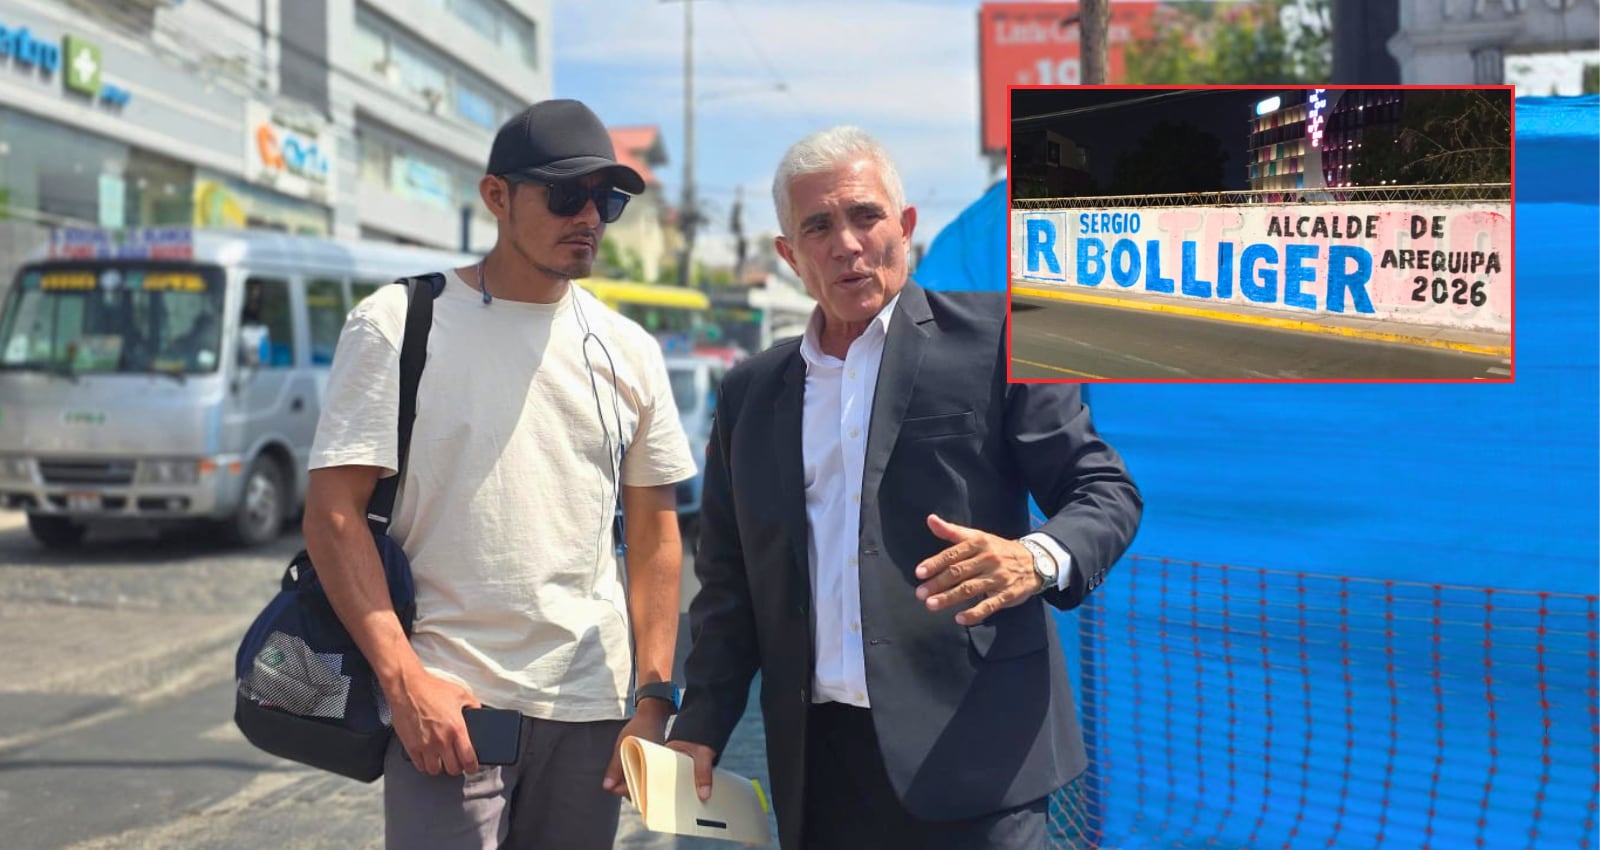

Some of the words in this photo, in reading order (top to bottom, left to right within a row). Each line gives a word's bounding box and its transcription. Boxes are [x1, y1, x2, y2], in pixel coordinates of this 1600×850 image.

[1079, 212, 1141, 235] SERGIO
[1266, 215, 1380, 239] ALCALDE
[1410, 214, 1447, 240] DE
[1026, 219, 1062, 275] R
[1076, 236, 1376, 314] BOLLIGER
[1380, 249, 1502, 275] AREQUIPA
[1411, 276, 1488, 307] 2026
